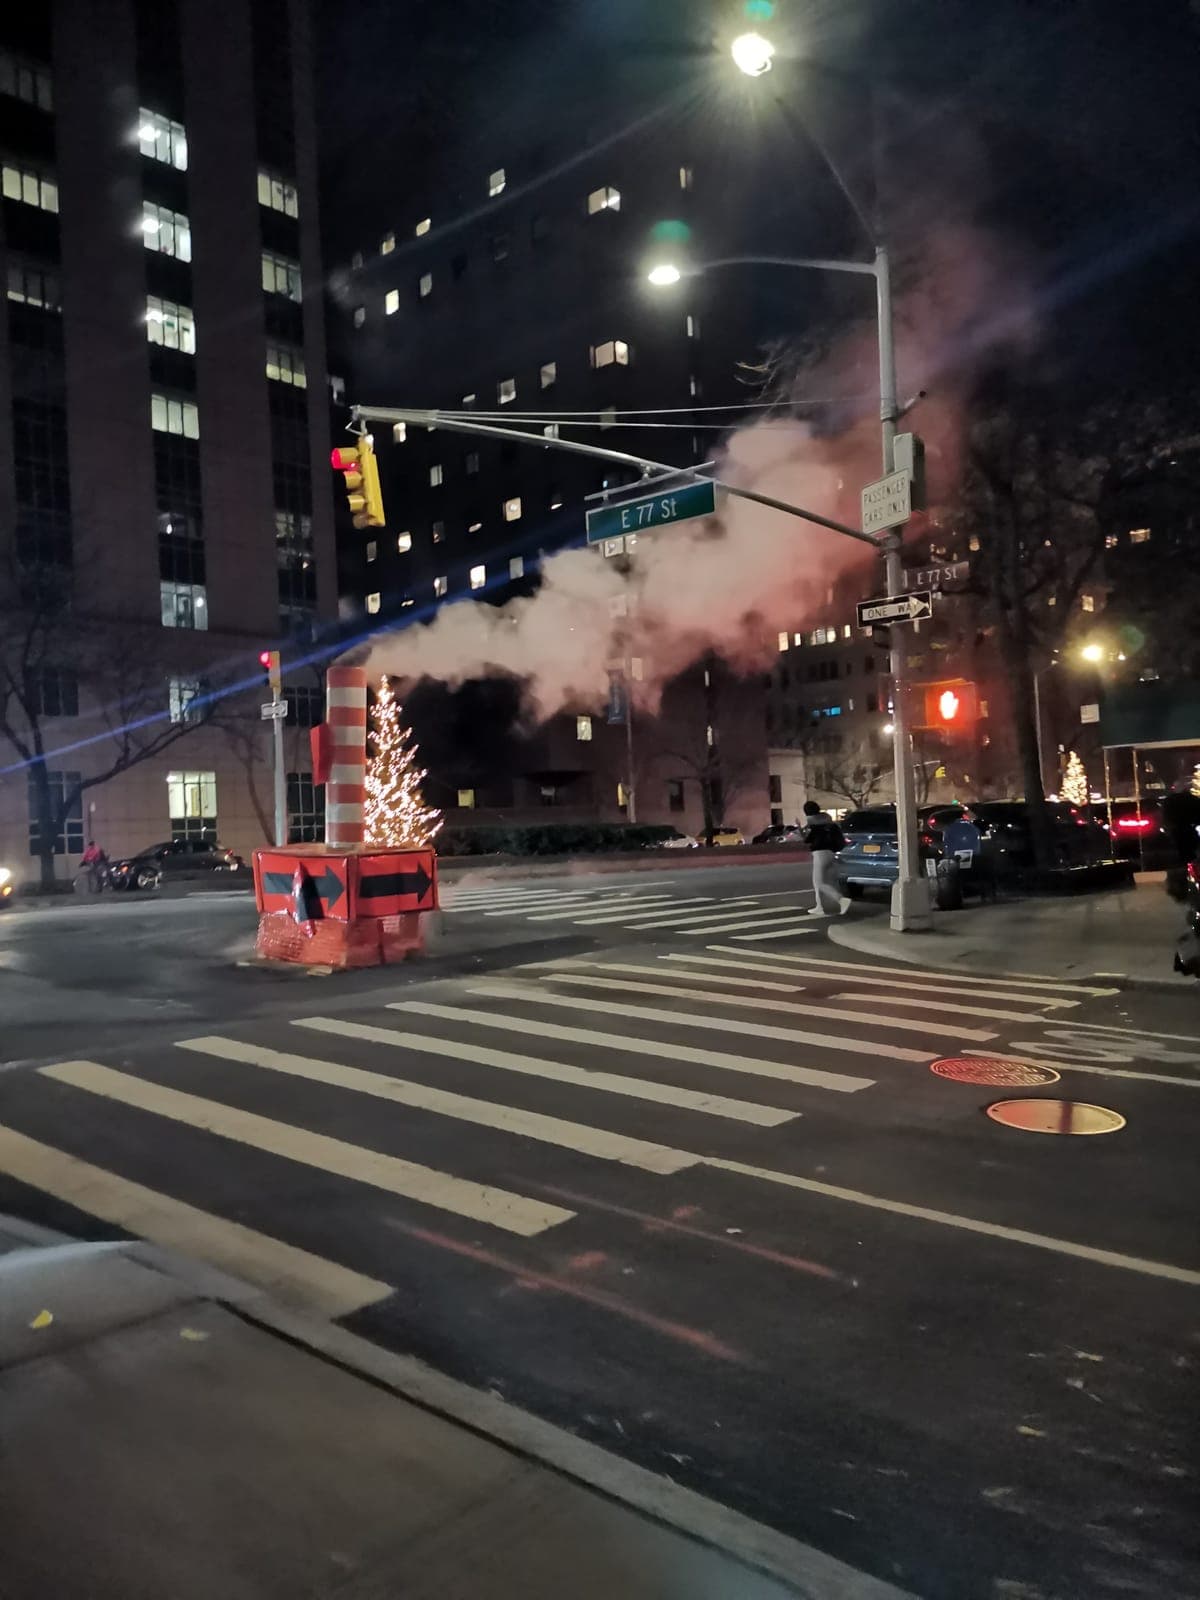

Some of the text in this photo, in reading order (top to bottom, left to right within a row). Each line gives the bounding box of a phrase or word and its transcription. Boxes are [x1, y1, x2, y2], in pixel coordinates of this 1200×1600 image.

[864, 476, 905, 503] PASSENGER
[621, 498, 677, 529] E 77 St
[917, 572, 924, 585] E
[927, 569, 940, 583] 77
[867, 602, 918, 619] ONE WAY
